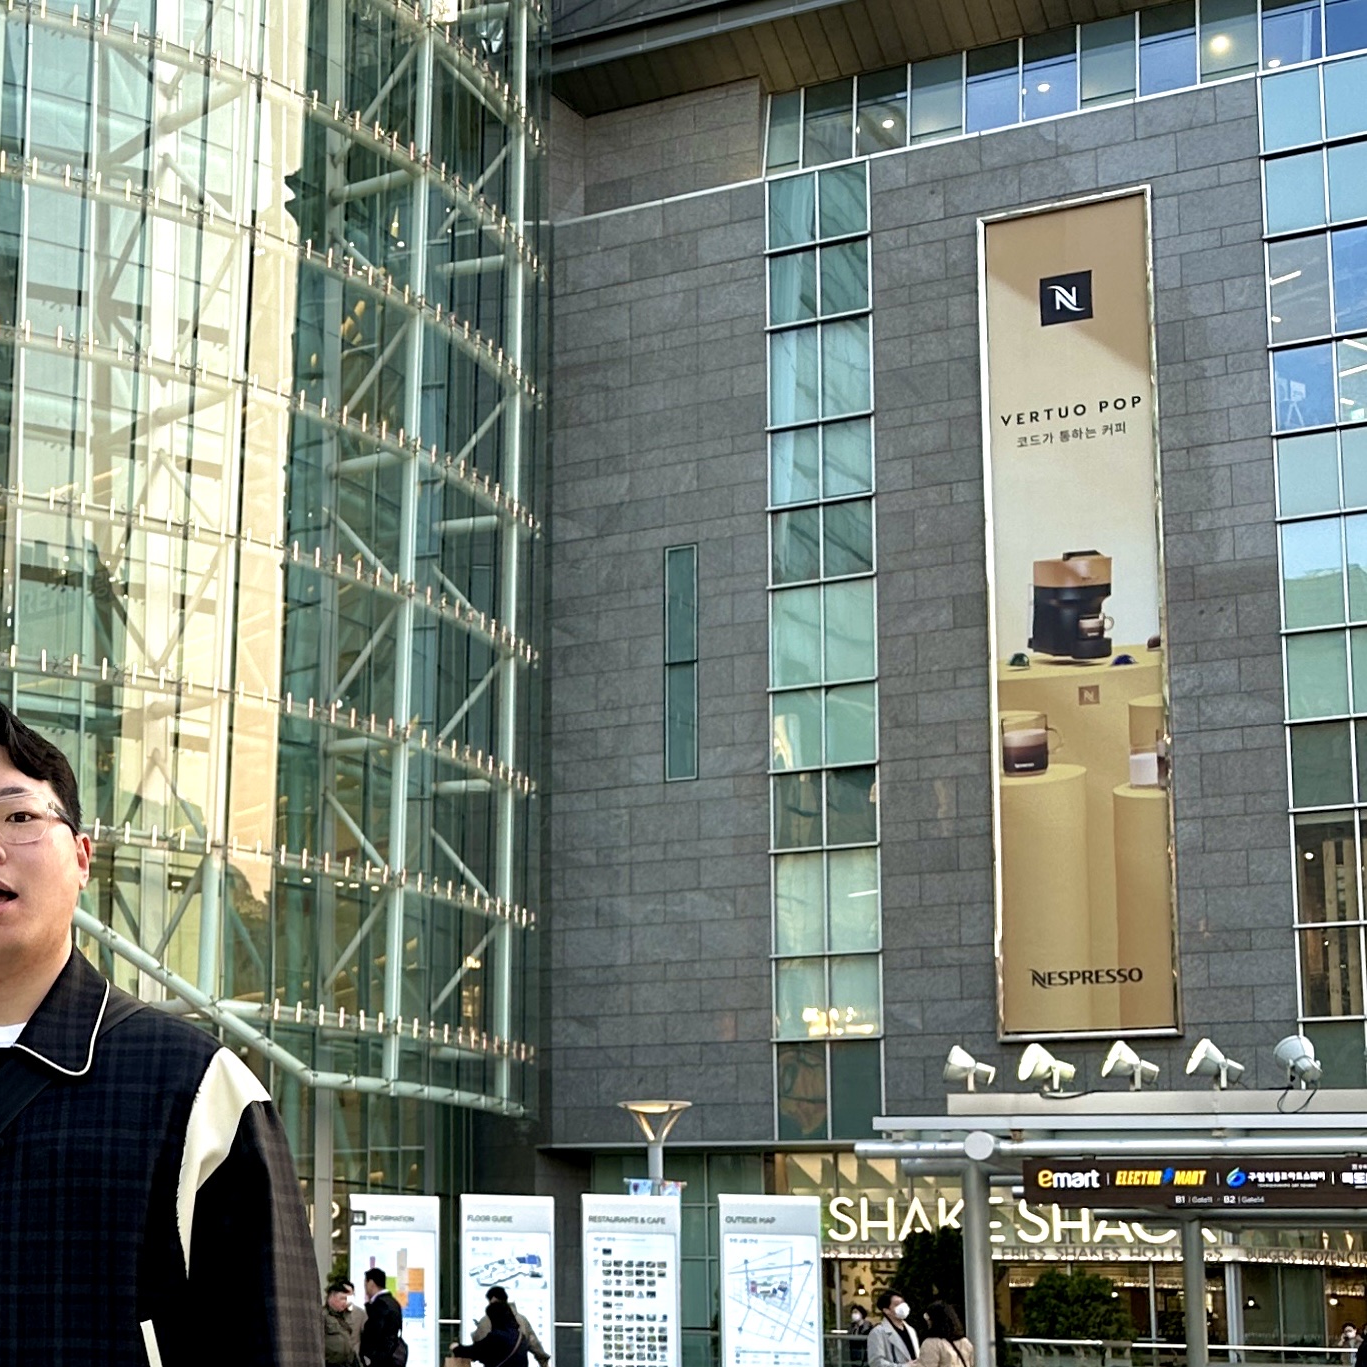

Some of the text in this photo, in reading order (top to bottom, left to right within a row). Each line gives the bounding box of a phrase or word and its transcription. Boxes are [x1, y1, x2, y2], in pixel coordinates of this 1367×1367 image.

[1001, 395, 1142, 426] VERTUO POP
[1016, 421, 1127, 448] 코드가 통하는 커피
[1030, 967, 1143, 989] NESPRESSO
[1038, 1169, 1100, 1188] emart
[1223, 1195, 1236, 1204] B2
[467, 1215, 513, 1223] FLOOR GUIDE
[588, 1215, 639, 1224] RESTAURANTS
[647, 1216, 666, 1225] CAFE
[725, 1215, 775, 1225] OUTSIDE MAP
[1017, 1198, 1218, 1244] SHA
[1056, 1245, 1121, 1260] SHAKES
